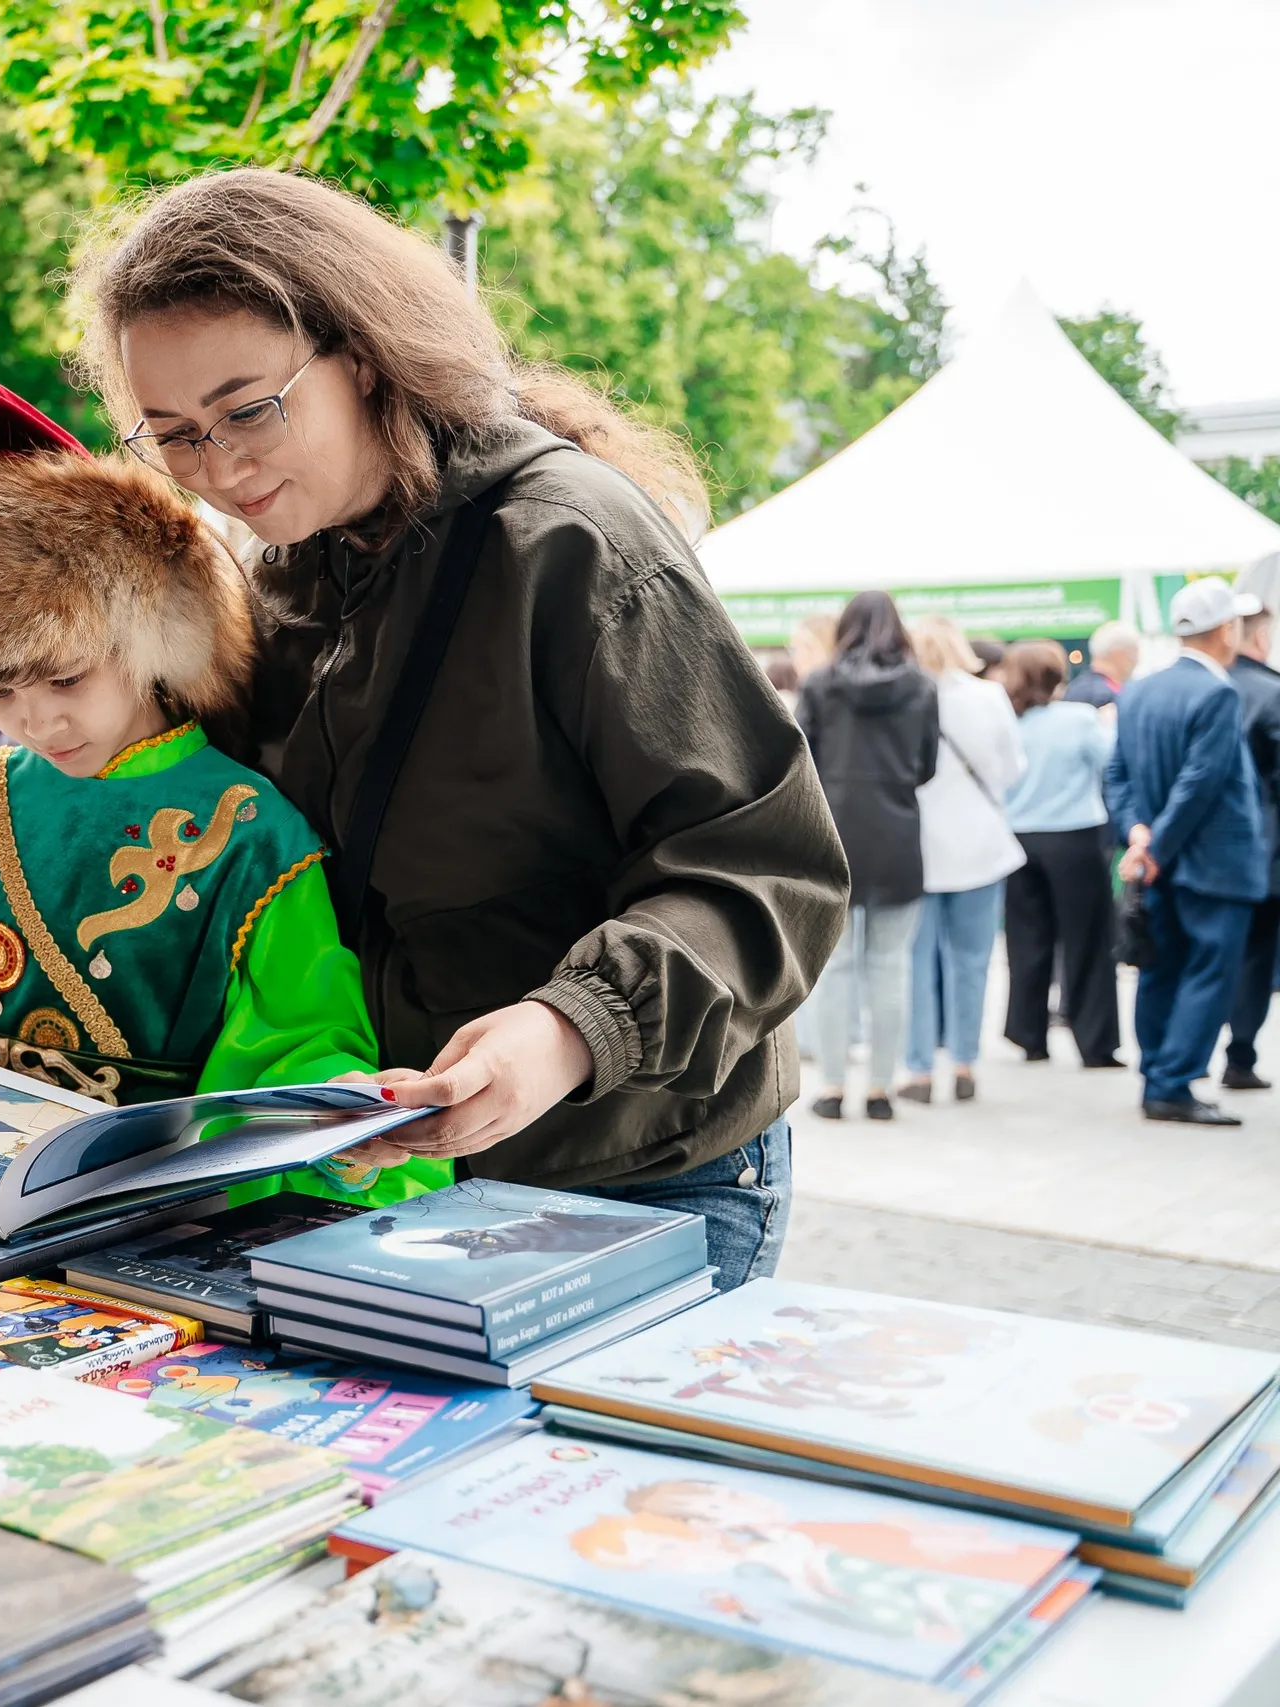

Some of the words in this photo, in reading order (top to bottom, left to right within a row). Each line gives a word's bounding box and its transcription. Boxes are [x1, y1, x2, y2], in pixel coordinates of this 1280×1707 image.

[541, 1286, 558, 1303] КОТ
[563, 1272, 591, 1293] ВОРОН
[545, 1312, 562, 1328] КОТ
[567, 1298, 594, 1318] ВОРОН
